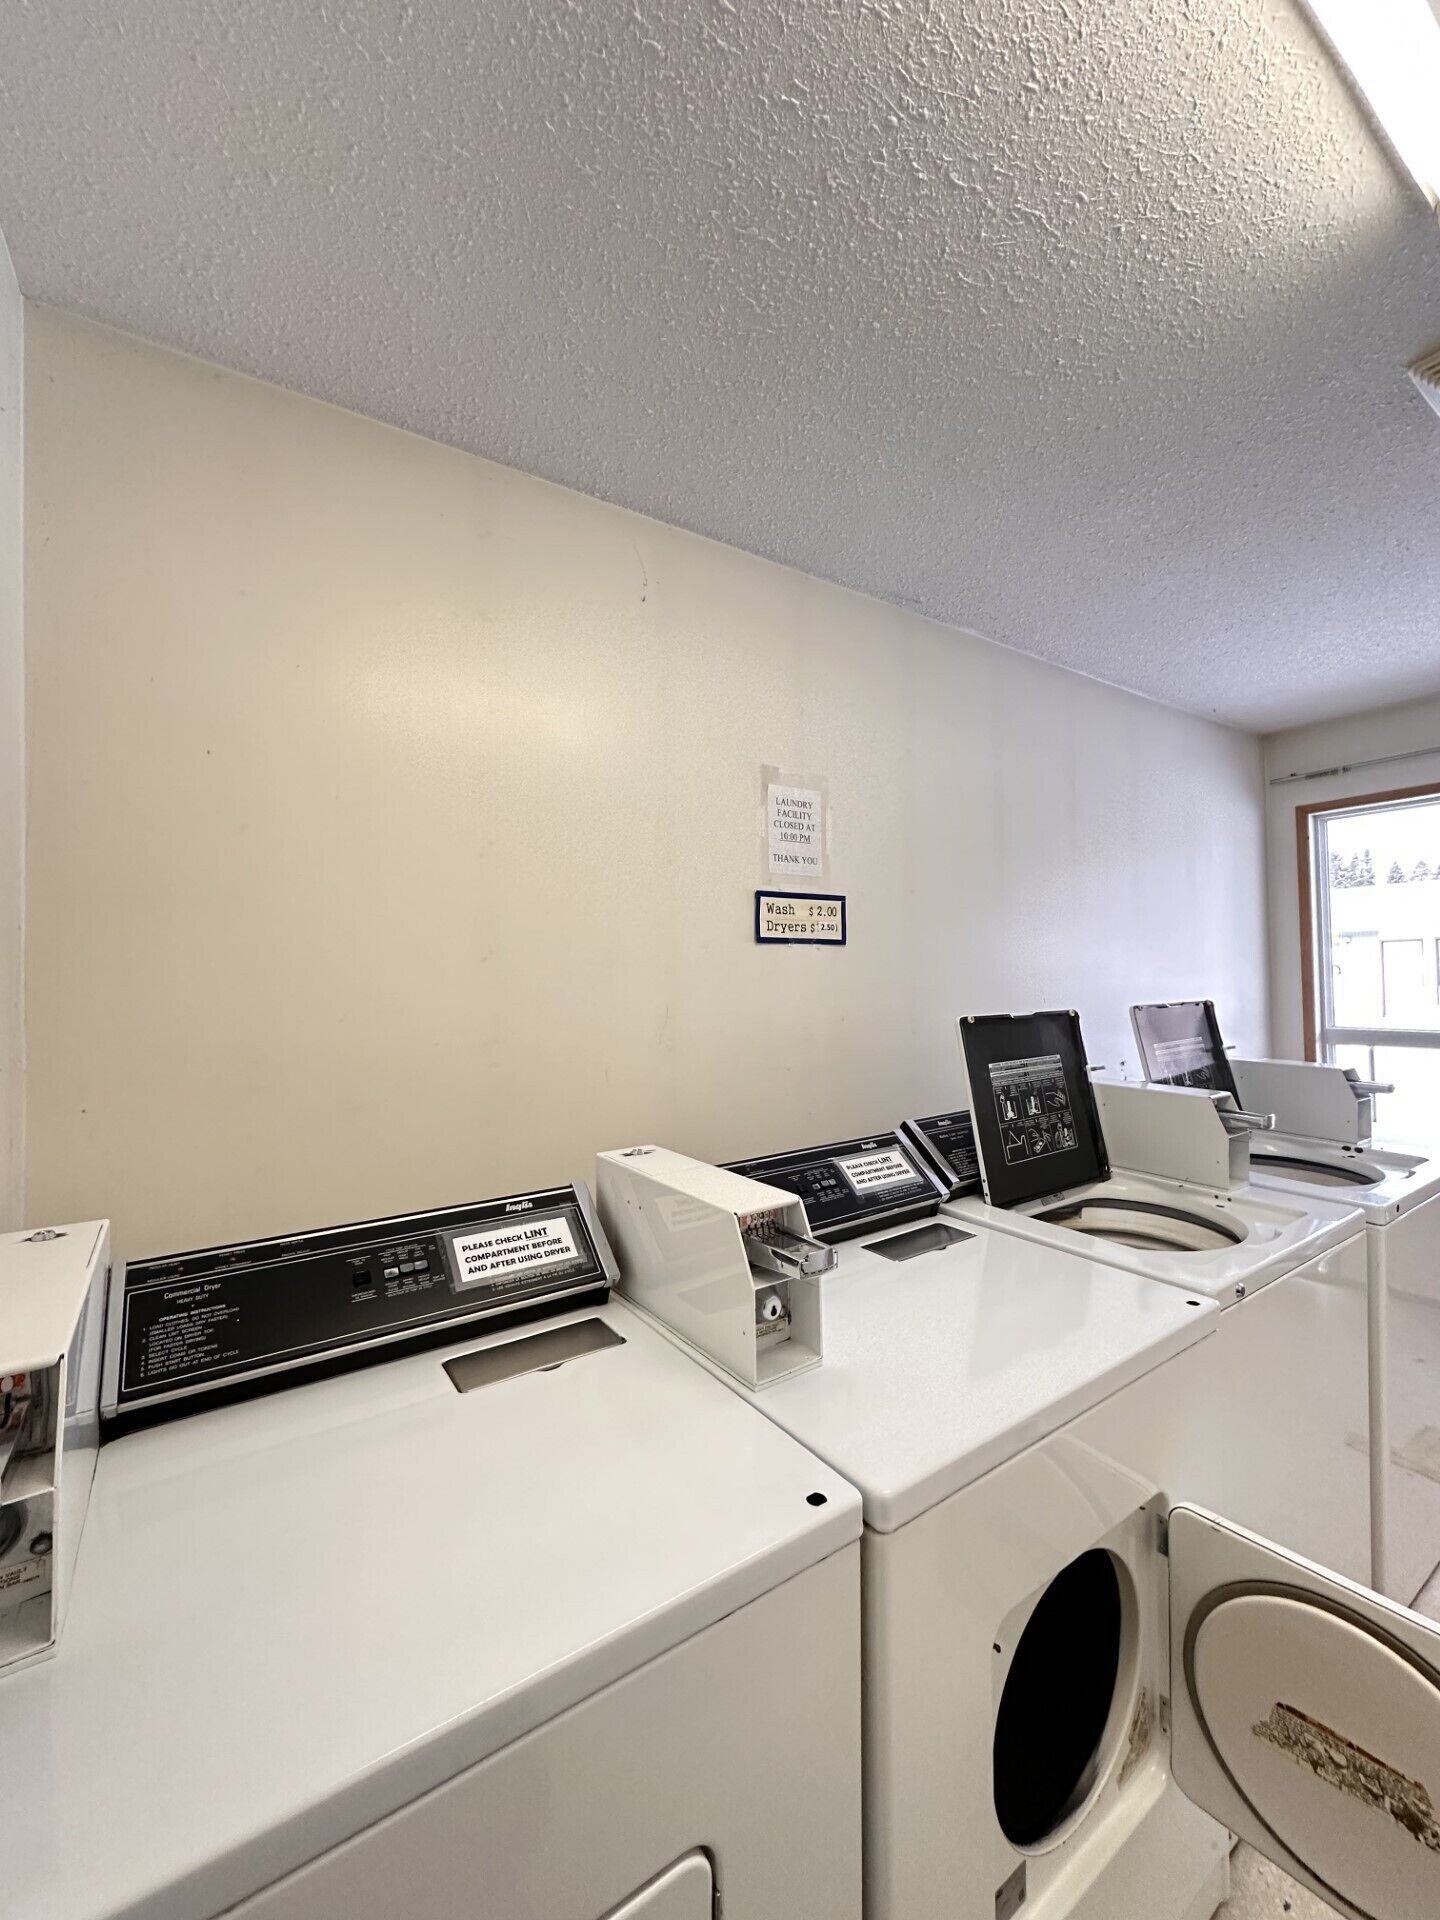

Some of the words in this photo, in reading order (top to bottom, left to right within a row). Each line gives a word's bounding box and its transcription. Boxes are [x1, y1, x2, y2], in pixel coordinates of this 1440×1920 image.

[775, 797, 813, 810] LAUNDRY
[777, 808, 813, 821] FACILITY
[773, 820, 804, 831] CLOSED
[805, 823, 816, 832] AT
[780, 832, 798, 842] 10:00
[799, 833, 811, 843] PM
[773, 853, 800, 864] THANK
[801, 856, 818, 866] YOU
[766, 902, 796, 915] Wash
[816, 905, 837, 917] 2.00
[766, 920, 807, 933] Dryers
[877, 1156, 892, 1164] LINT
[851, 1166, 885, 1178] COMPARTMENT
[461, 1240, 494, 1252] PLEASE
[494, 1235, 523, 1246] CHECK
[523, 1227, 548, 1240] LINT
[465, 1245, 530, 1264] COMPARTMENT
[532, 1237, 563, 1249] BEFORE
[468, 1264, 488, 1275] AND
[490, 1258, 517, 1270] AFTER
[517, 1252, 543, 1264] USING
[544, 1245, 571, 1257] DRYER
[164, 1287, 201, 1299] Commercial
[204, 1283, 221, 1291] Dryer
[176, 1296, 194, 1304] HEAVY
[195, 1293, 209, 1301] DUTY
